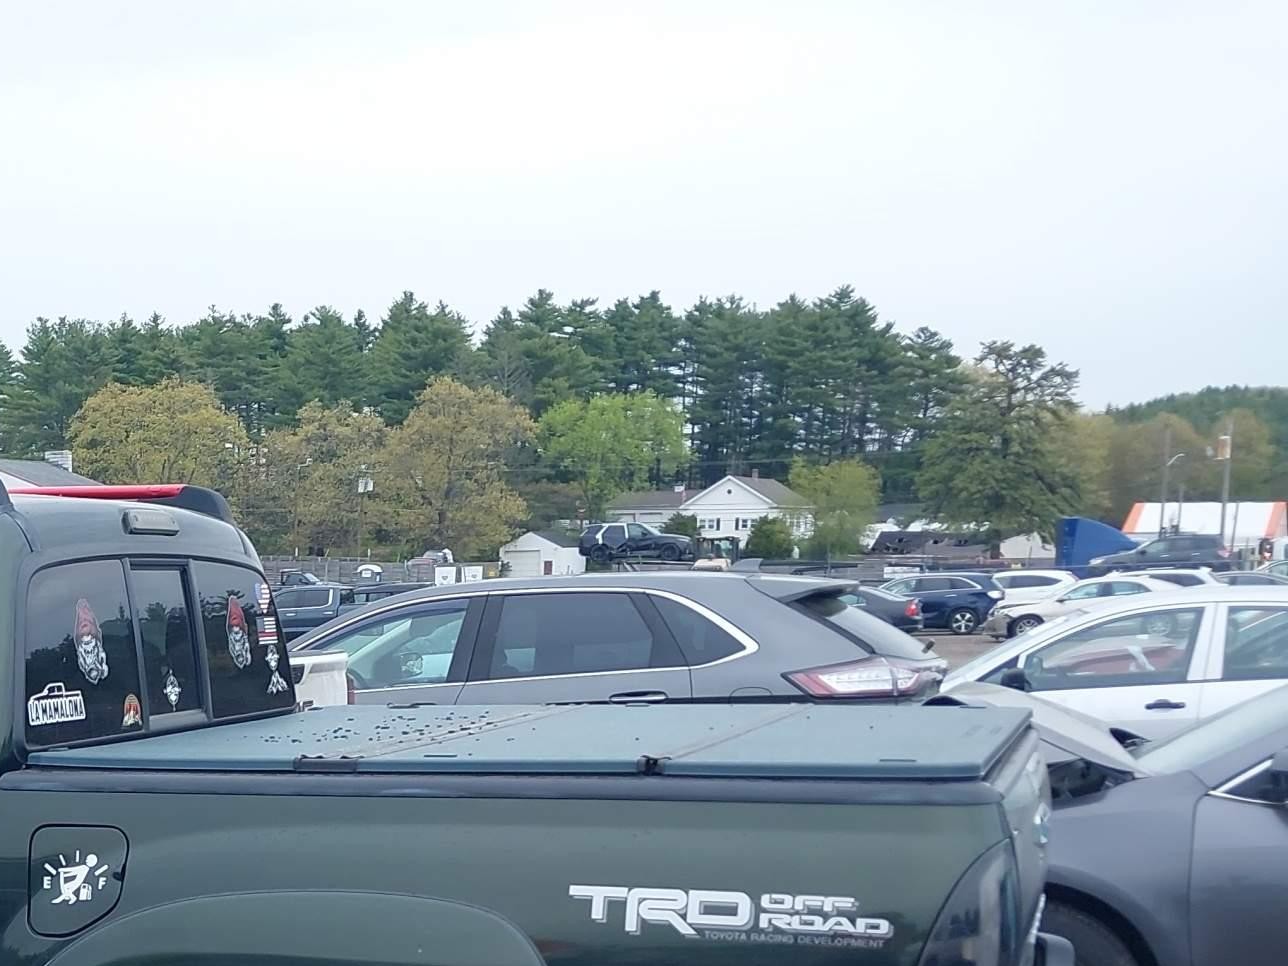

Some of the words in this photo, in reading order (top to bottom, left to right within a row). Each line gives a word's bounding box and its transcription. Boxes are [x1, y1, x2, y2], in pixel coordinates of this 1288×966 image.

[43, 876, 52, 889] E
[98, 876, 107, 890] F
[568, 884, 755, 938] TRD
[760, 893, 859, 914] OFF
[759, 912, 894, 938] ROAD
[704, 930, 747, 941] TOYOTA
[750, 933, 794, 944] RACING
[797, 935, 885, 948] DEVELOPMENT
